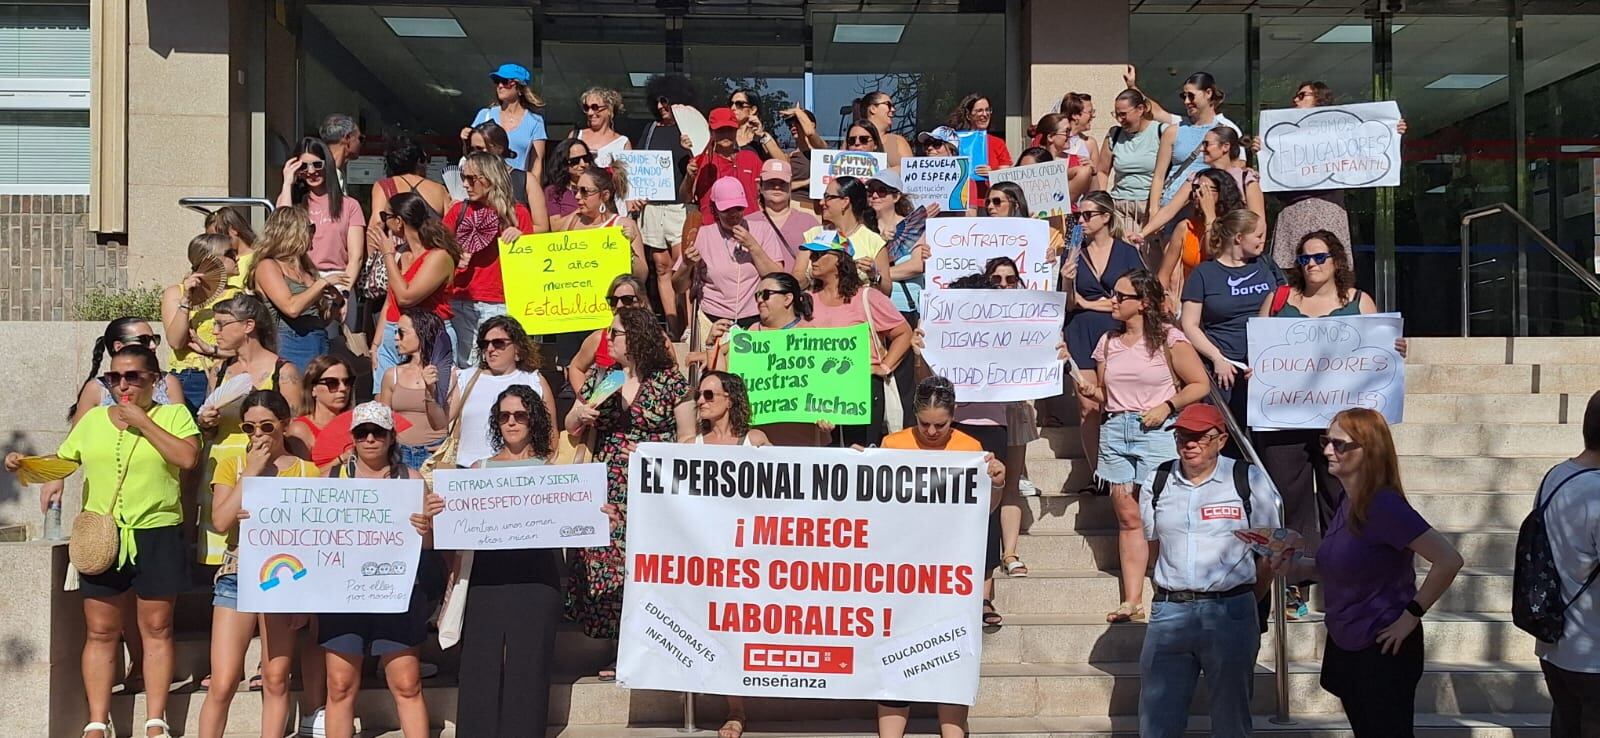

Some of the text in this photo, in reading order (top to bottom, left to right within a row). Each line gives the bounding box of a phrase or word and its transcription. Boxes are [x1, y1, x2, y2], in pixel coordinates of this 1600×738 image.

[1308, 117, 1356, 133] SOMOS
[841, 154, 878, 167] FUTURO
[1279, 132, 1388, 174] EDUCADORES
[630, 166, 662, 176] UANDO
[832, 165, 873, 176] EMPIEZA
[907, 159, 956, 169] LA ESCUELA
[1302, 159, 1388, 176] DE INFANTIL
[905, 172, 918, 183] NO
[508, 235, 618, 254] Las aulas de
[934, 223, 1029, 248] CONTRATOS
[543, 258, 599, 272] 2 años
[936, 258, 977, 271] DESDE
[1015, 250, 1027, 274] 1
[1034, 262, 1050, 273] DE
[543, 280, 593, 292] merecen
[1231, 283, 1270, 296] barça
[524, 293, 610, 317] Estabilida
[958, 303, 1060, 320] CONDICIONES
[733, 333, 858, 354] Sus Primeros
[941, 331, 1051, 348] DIGNAS NO HAY
[1293, 325, 1350, 344] SOMOS
[767, 353, 815, 371] Pasos
[1261, 355, 1389, 373] EDUCADORES
[752, 397, 798, 416] meras
[1267, 390, 1379, 409] INFANTILES
[448, 479, 494, 492] ENTRADA
[496, 476, 536, 488] SALIDA
[539, 475, 547, 485] Y
[640, 457, 978, 504] EL PERSONAL NO DOCENTE
[279, 488, 379, 504] ITINERANTES
[472, 495, 521, 511] RESPETO
[523, 494, 530, 506] Y
[531, 490, 593, 506] COHERENCIA!
[259, 507, 291, 524] CON
[1204, 506, 1239, 516] CCOO
[502, 521, 523, 530] unos
[752, 515, 869, 549] MERECE
[248, 528, 405, 547] CONDICIONES DIGNAS
[317, 550, 345, 569] ¡YA!
[634, 553, 973, 596] MEJORES CONDICIONES
[346, 578, 366, 593] Por
[346, 592, 366, 604] por
[708, 601, 874, 638] LABORALES
[644, 602, 716, 663] EDUCADORAS/ES
[645, 626, 694, 669] INFANTILES
[881, 626, 967, 666] EDUCADORAS/ES
[749, 648, 820, 668] CCOO
[903, 649, 961, 679] INFANTILES
[743, 674, 827, 689] enseñanza
